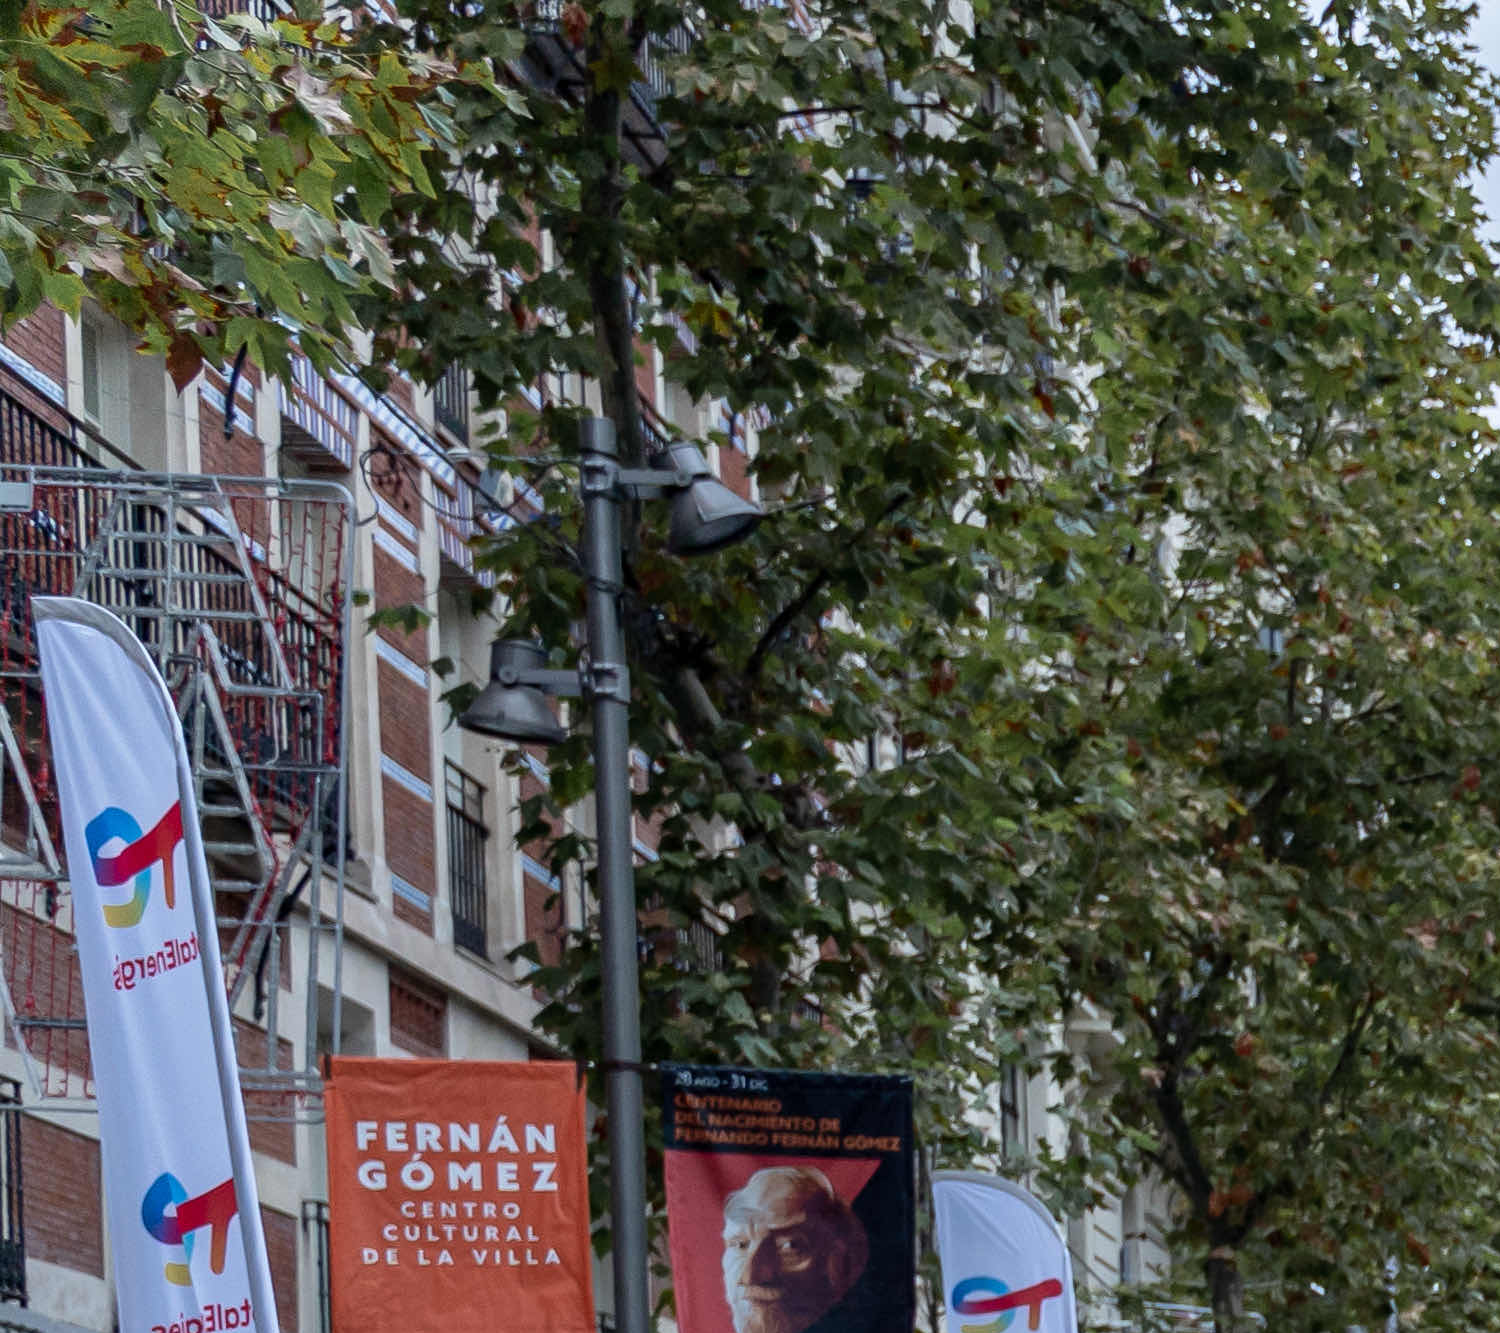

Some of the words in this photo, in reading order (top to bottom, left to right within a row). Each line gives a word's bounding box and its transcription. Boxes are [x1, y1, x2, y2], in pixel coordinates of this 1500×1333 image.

[708, 1113, 816, 1131] NACIMIENTO
[819, 1117, 841, 1132] DE
[356, 1115, 557, 1153] FERNÁN
[674, 1126, 769, 1147] FERNANDO
[772, 1132, 840, 1149] FERNÁN
[843, 1134, 902, 1152] GÓMEZ
[357, 1153, 559, 1191] GÓMEZ
[400, 1202, 521, 1219] CENTRO
[382, 1224, 541, 1242] CULTURAL
[362, 1248, 400, 1265] DE
[416, 1248, 455, 1266] LA
[472, 1248, 562, 1266] VILLA
